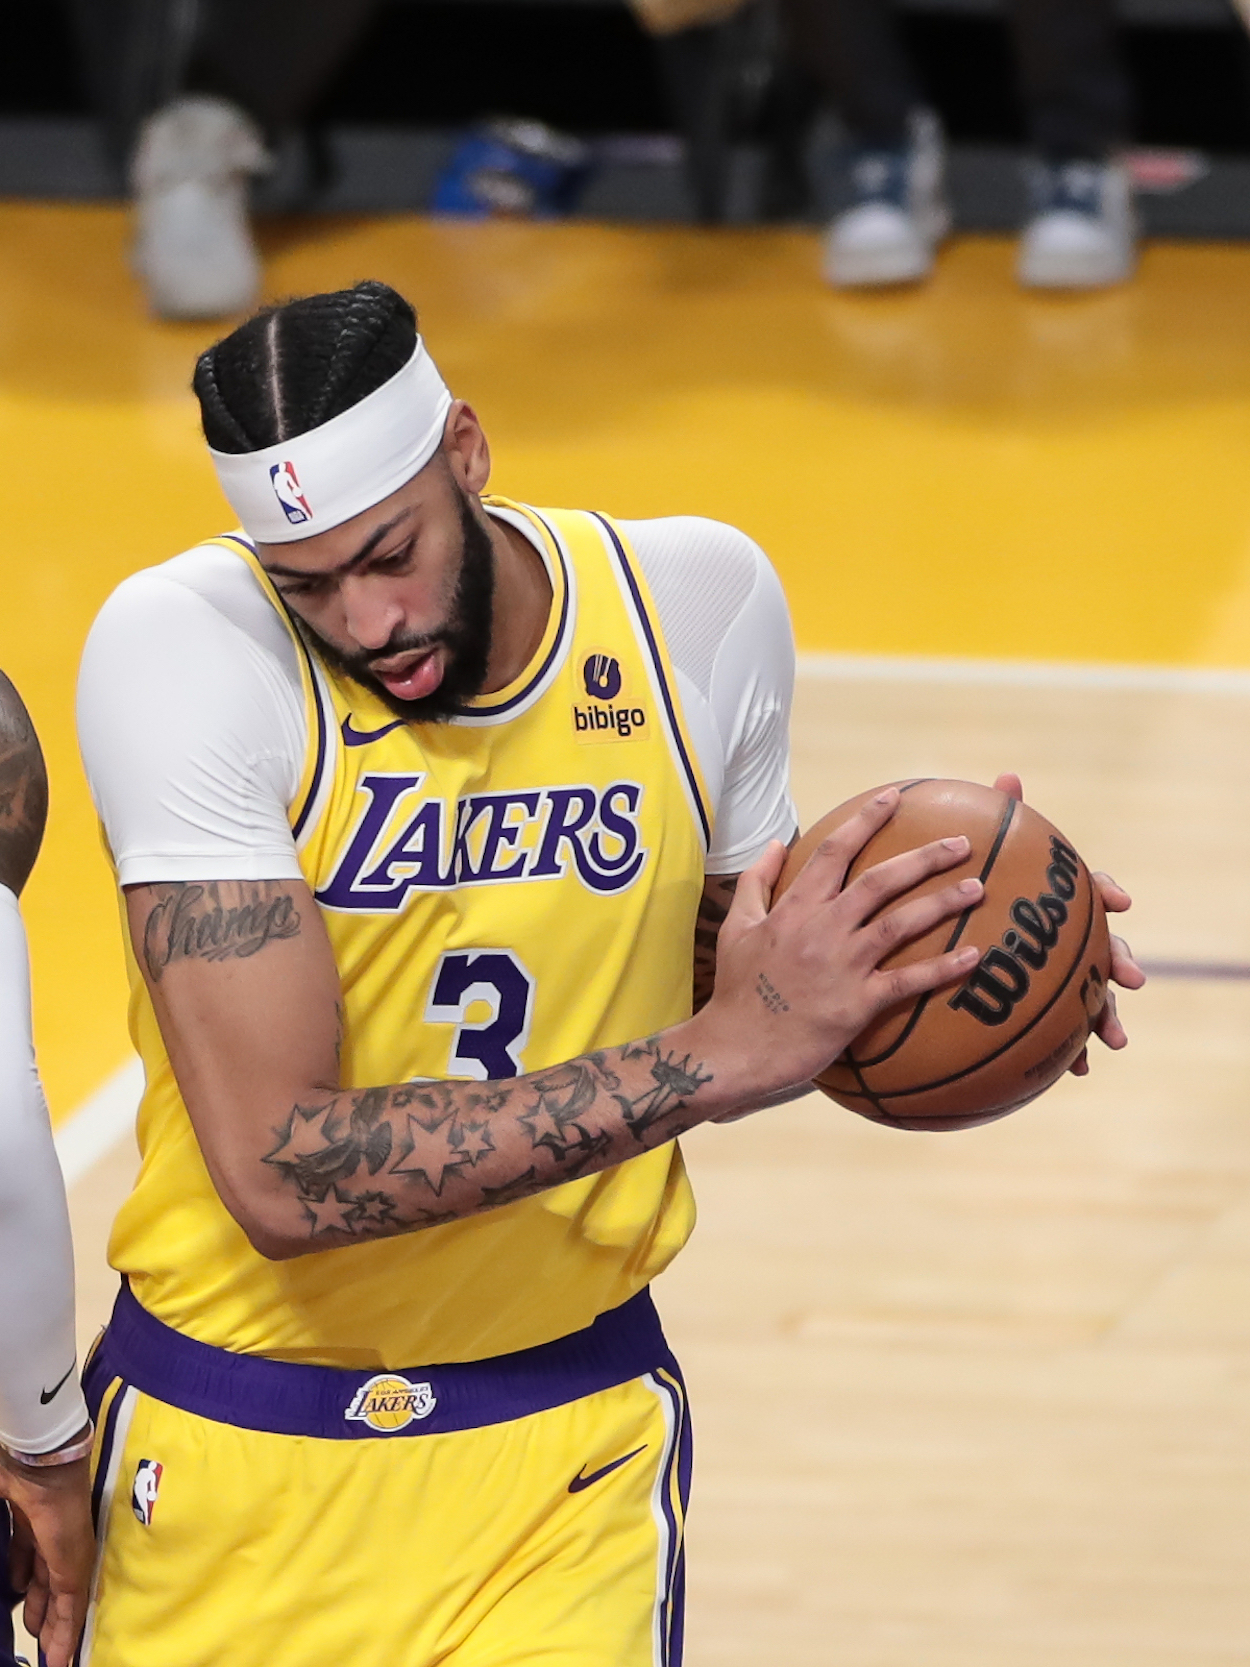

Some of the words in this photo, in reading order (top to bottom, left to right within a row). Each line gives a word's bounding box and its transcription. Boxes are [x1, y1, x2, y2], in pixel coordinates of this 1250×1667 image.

[574, 704, 645, 737] bibigo
[314, 772, 648, 913] LAKERS
[948, 834, 1080, 1026] Wilson
[423, 949, 535, 1082] 3
[350, 1391, 432, 1416] LAKERS
